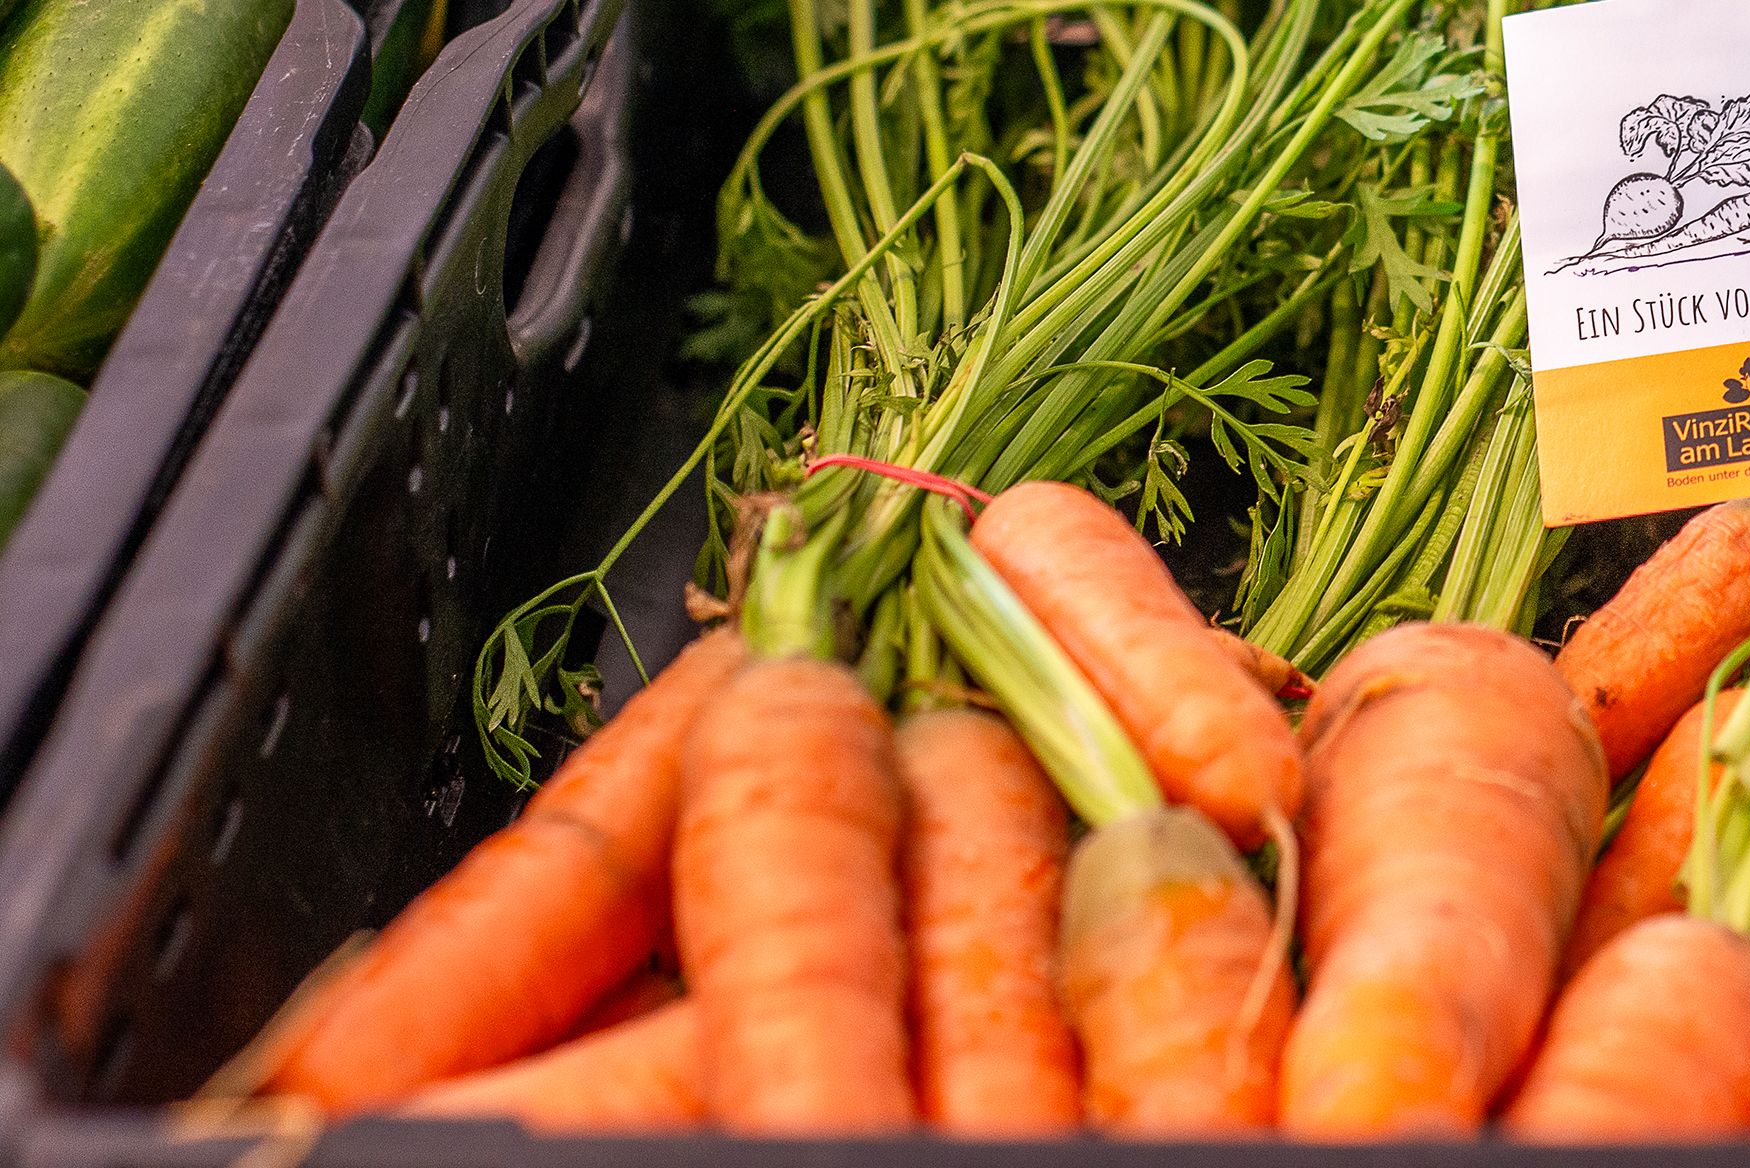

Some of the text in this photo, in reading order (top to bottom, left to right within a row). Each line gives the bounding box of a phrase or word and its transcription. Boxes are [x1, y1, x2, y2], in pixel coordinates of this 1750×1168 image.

[1679, 443, 1721, 465] am
[1667, 473, 1705, 488] Boden
[1708, 467, 1741, 482] unter
